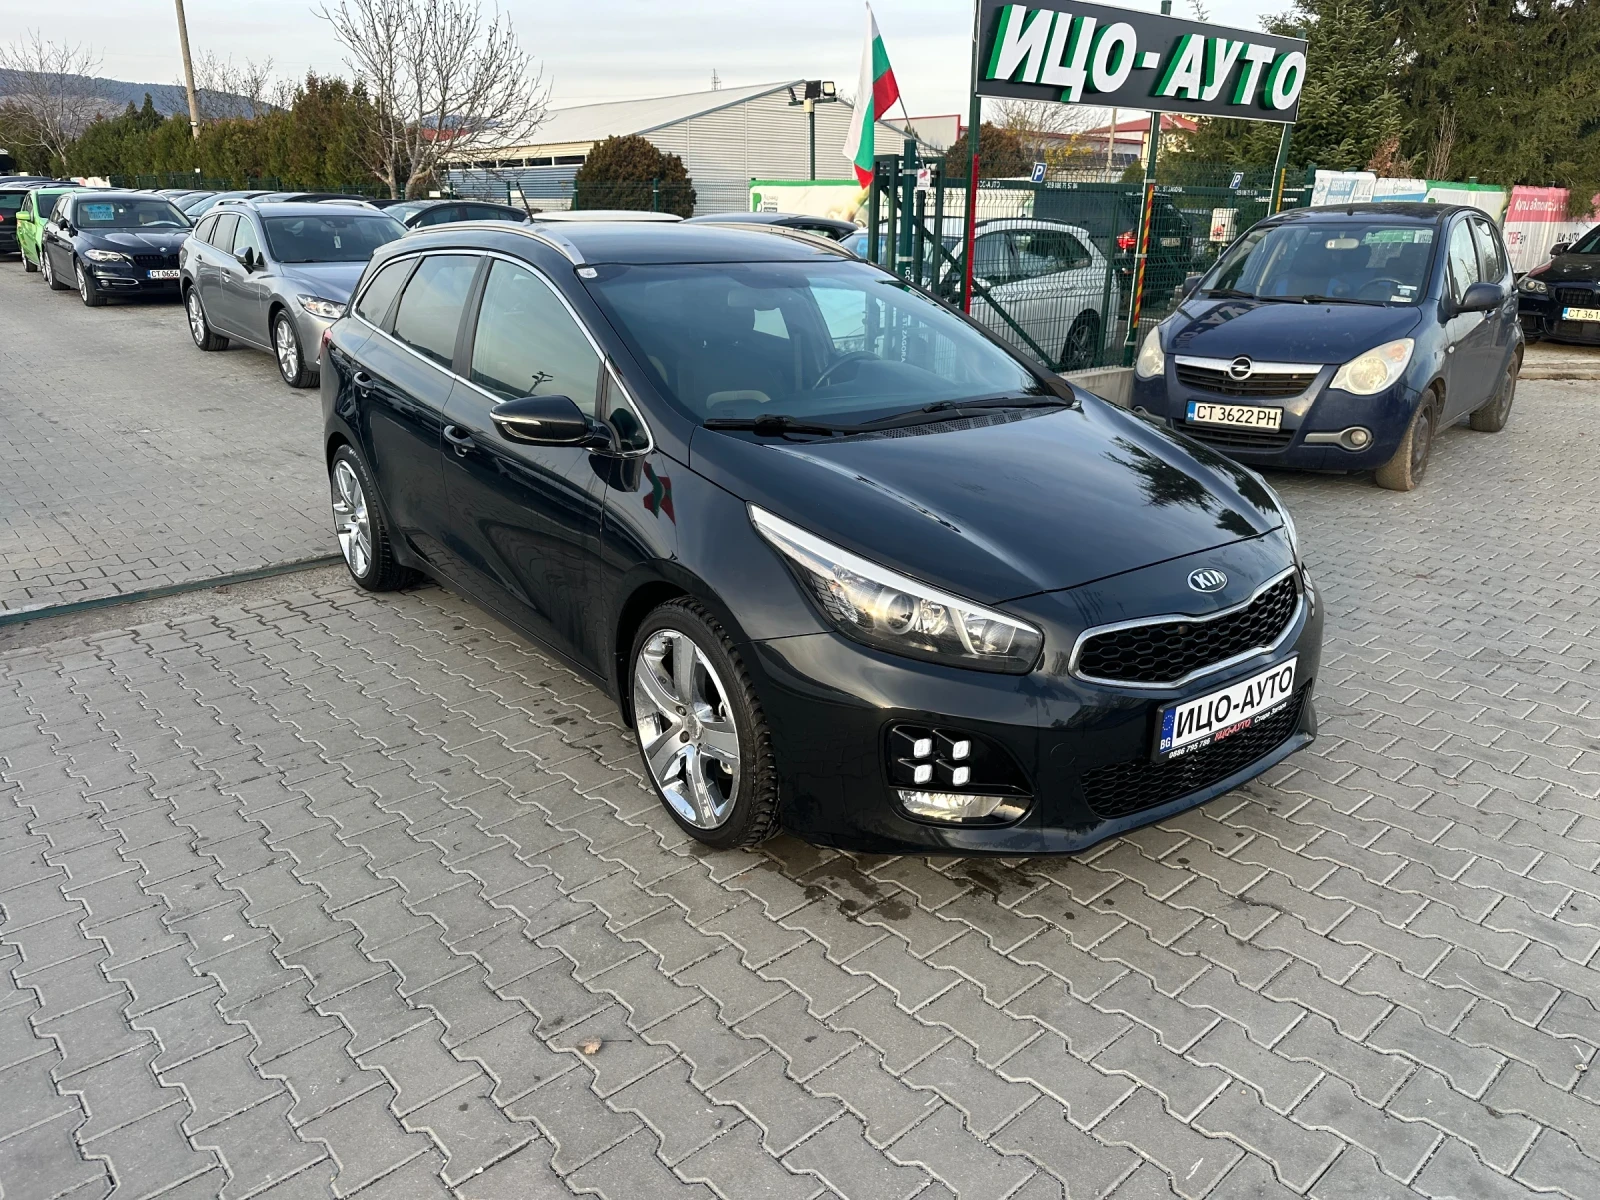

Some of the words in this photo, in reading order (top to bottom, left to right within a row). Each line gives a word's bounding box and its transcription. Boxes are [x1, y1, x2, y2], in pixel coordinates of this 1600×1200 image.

[988, 4, 1306, 110] ИЦО-АУТО
[1034, 166, 1044, 180] P
[1582, 310, 1600, 319] 361
[1197, 405, 1216, 420] CT
[1218, 407, 1254, 424] 3622
[1256, 410, 1278, 426] PH
[1193, 571, 1225, 589] KIA
[1176, 666, 1293, 739] ИЦО-АУТО
[1160, 737, 1171, 750] BG
